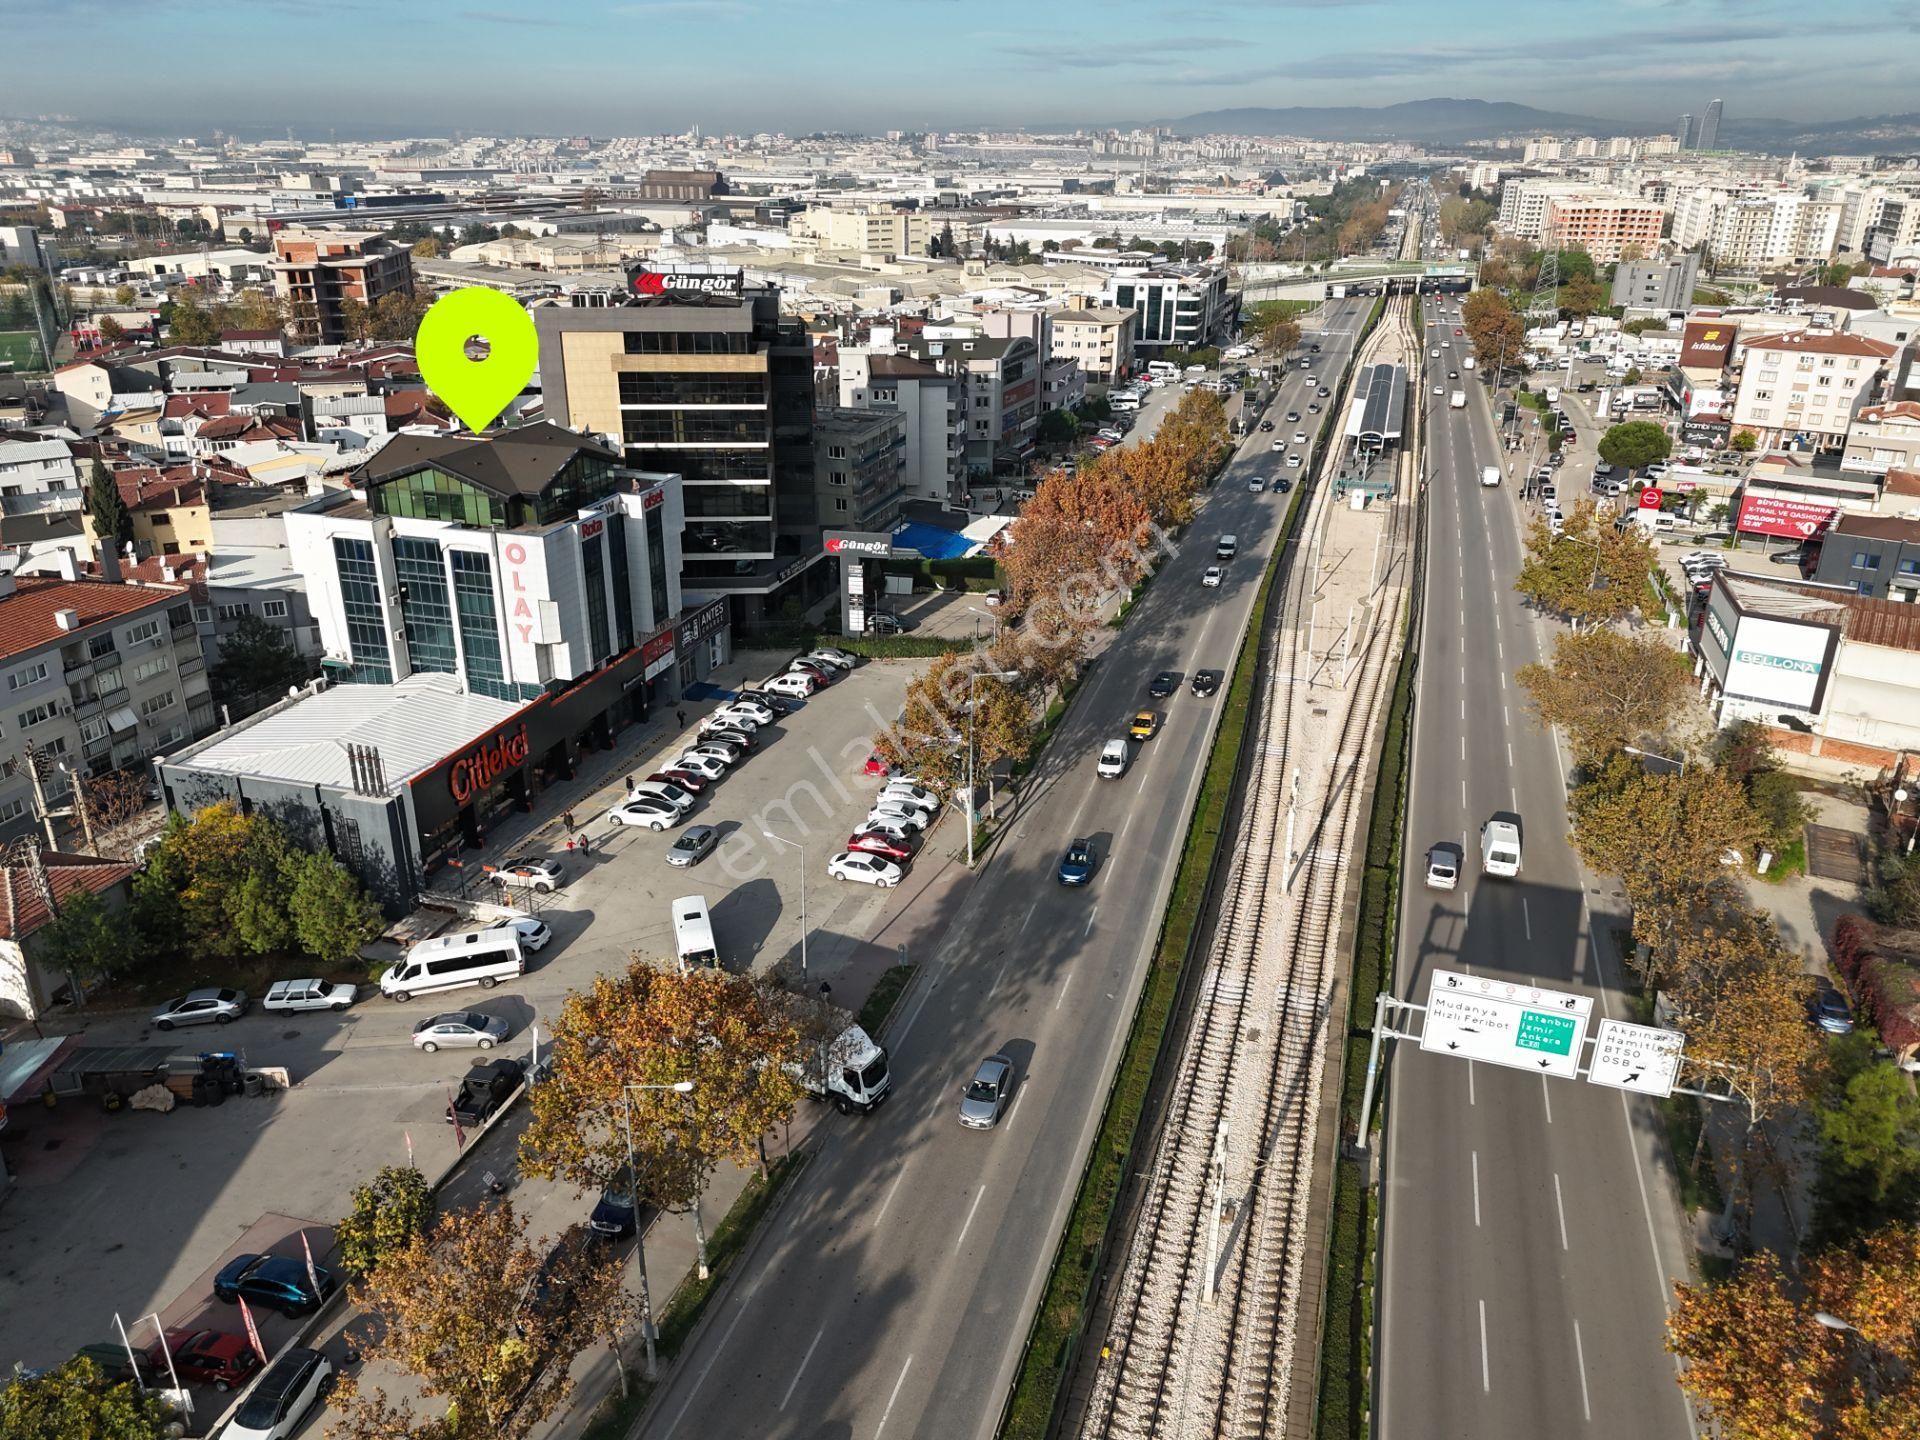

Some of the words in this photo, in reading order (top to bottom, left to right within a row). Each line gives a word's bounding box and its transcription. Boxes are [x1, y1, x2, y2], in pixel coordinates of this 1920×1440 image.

[662, 275, 736, 292] Güngör
[1691, 342, 1725, 352] istikbal
[1685, 421, 1710, 431] bambi
[1748, 506, 1777, 516] X-TRAIL
[1778, 509, 1788, 517] VE
[1757, 498, 1785, 508] BÜYÜK
[1786, 503, 1832, 514] KAMPANYA
[582, 519, 603, 539] Rota
[1776, 518, 1786, 526] TL
[838, 540, 889, 554] Güngör
[505, 543, 533, 643] OLAY
[701, 602, 724, 626] ANTES
[1741, 652, 1816, 674] BELLONA
[1435, 998, 1498, 1017] Mudanya
[1433, 1008, 1461, 1021] Hızlı
[1464, 1015, 1509, 1030] Feribot
[1522, 1011, 1574, 1029] İstanbul
[1521, 1021, 1554, 1035] İzmir
[1519, 1031, 1561, 1046] Ankara
[1604, 1045, 1641, 1058] BTSO
[1602, 1055, 1630, 1067] OSB
